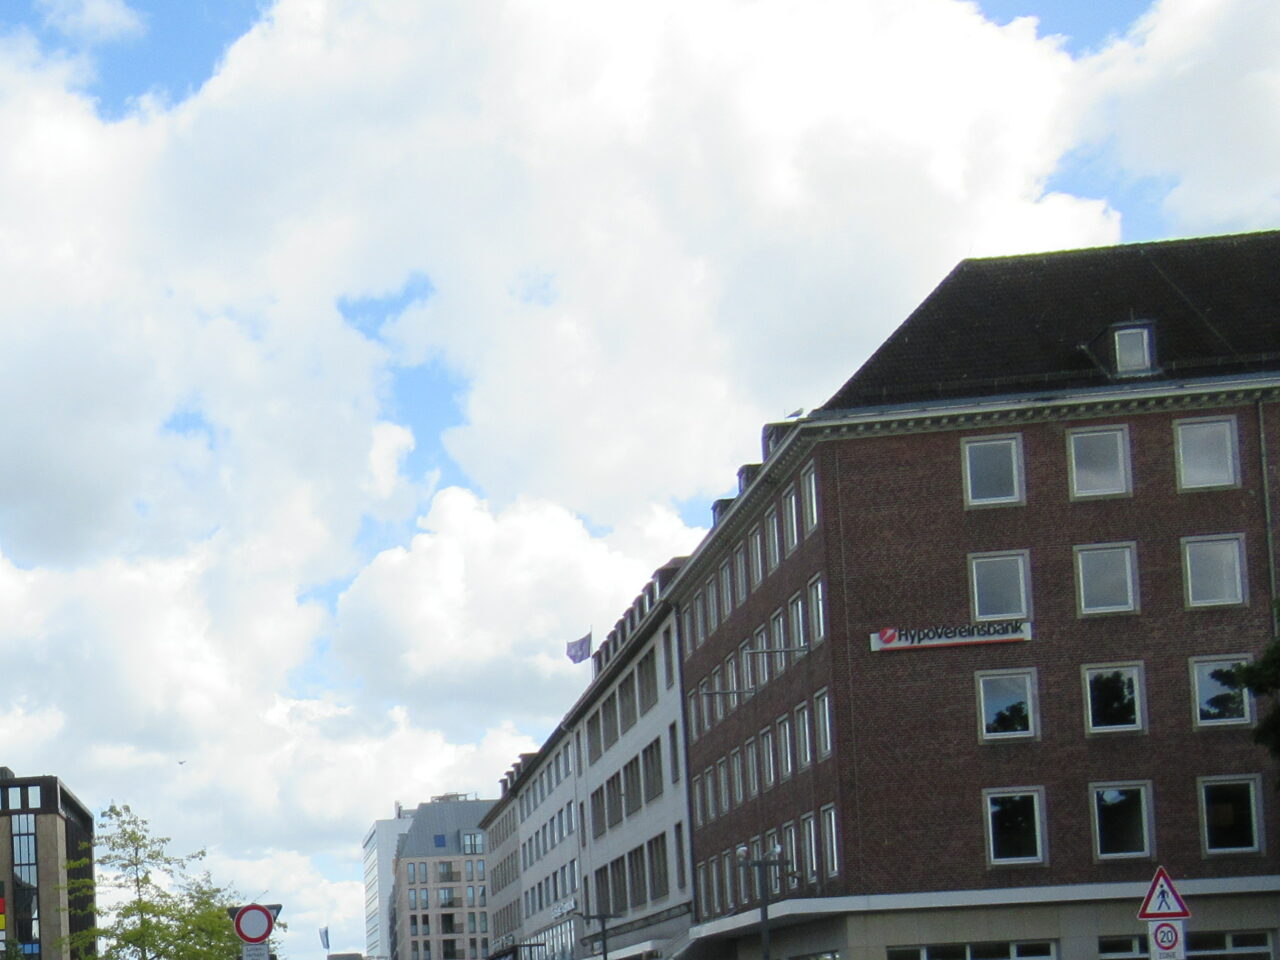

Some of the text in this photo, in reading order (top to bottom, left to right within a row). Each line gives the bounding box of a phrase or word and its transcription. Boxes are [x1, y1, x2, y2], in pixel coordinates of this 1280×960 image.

[898, 621, 1024, 645] HypoVereinsbank
[1160, 930, 1173, 943] 20
[1159, 952, 1176, 960] ZONE
